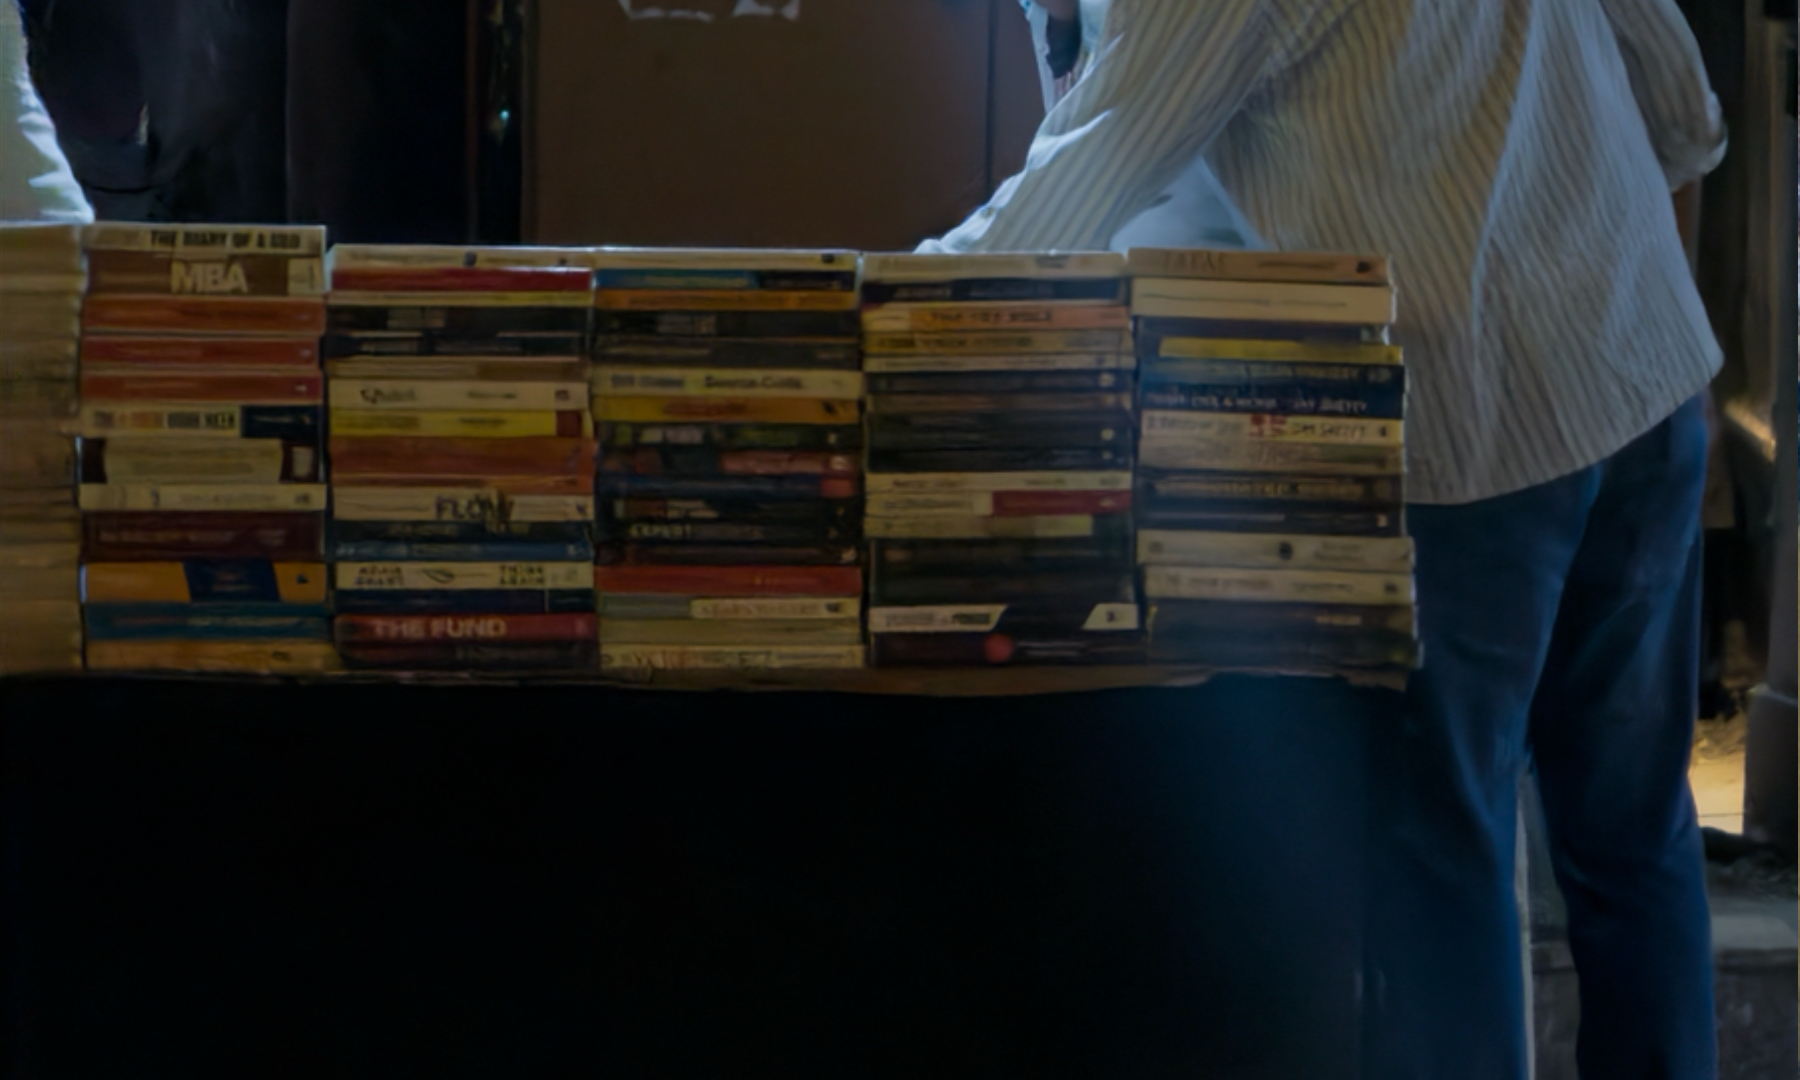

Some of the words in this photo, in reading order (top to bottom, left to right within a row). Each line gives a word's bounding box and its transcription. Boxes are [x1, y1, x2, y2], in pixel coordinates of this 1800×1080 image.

[170, 258, 248, 294] MBA
[371, 618, 425, 639] THE
[430, 616, 507, 640] FUND
